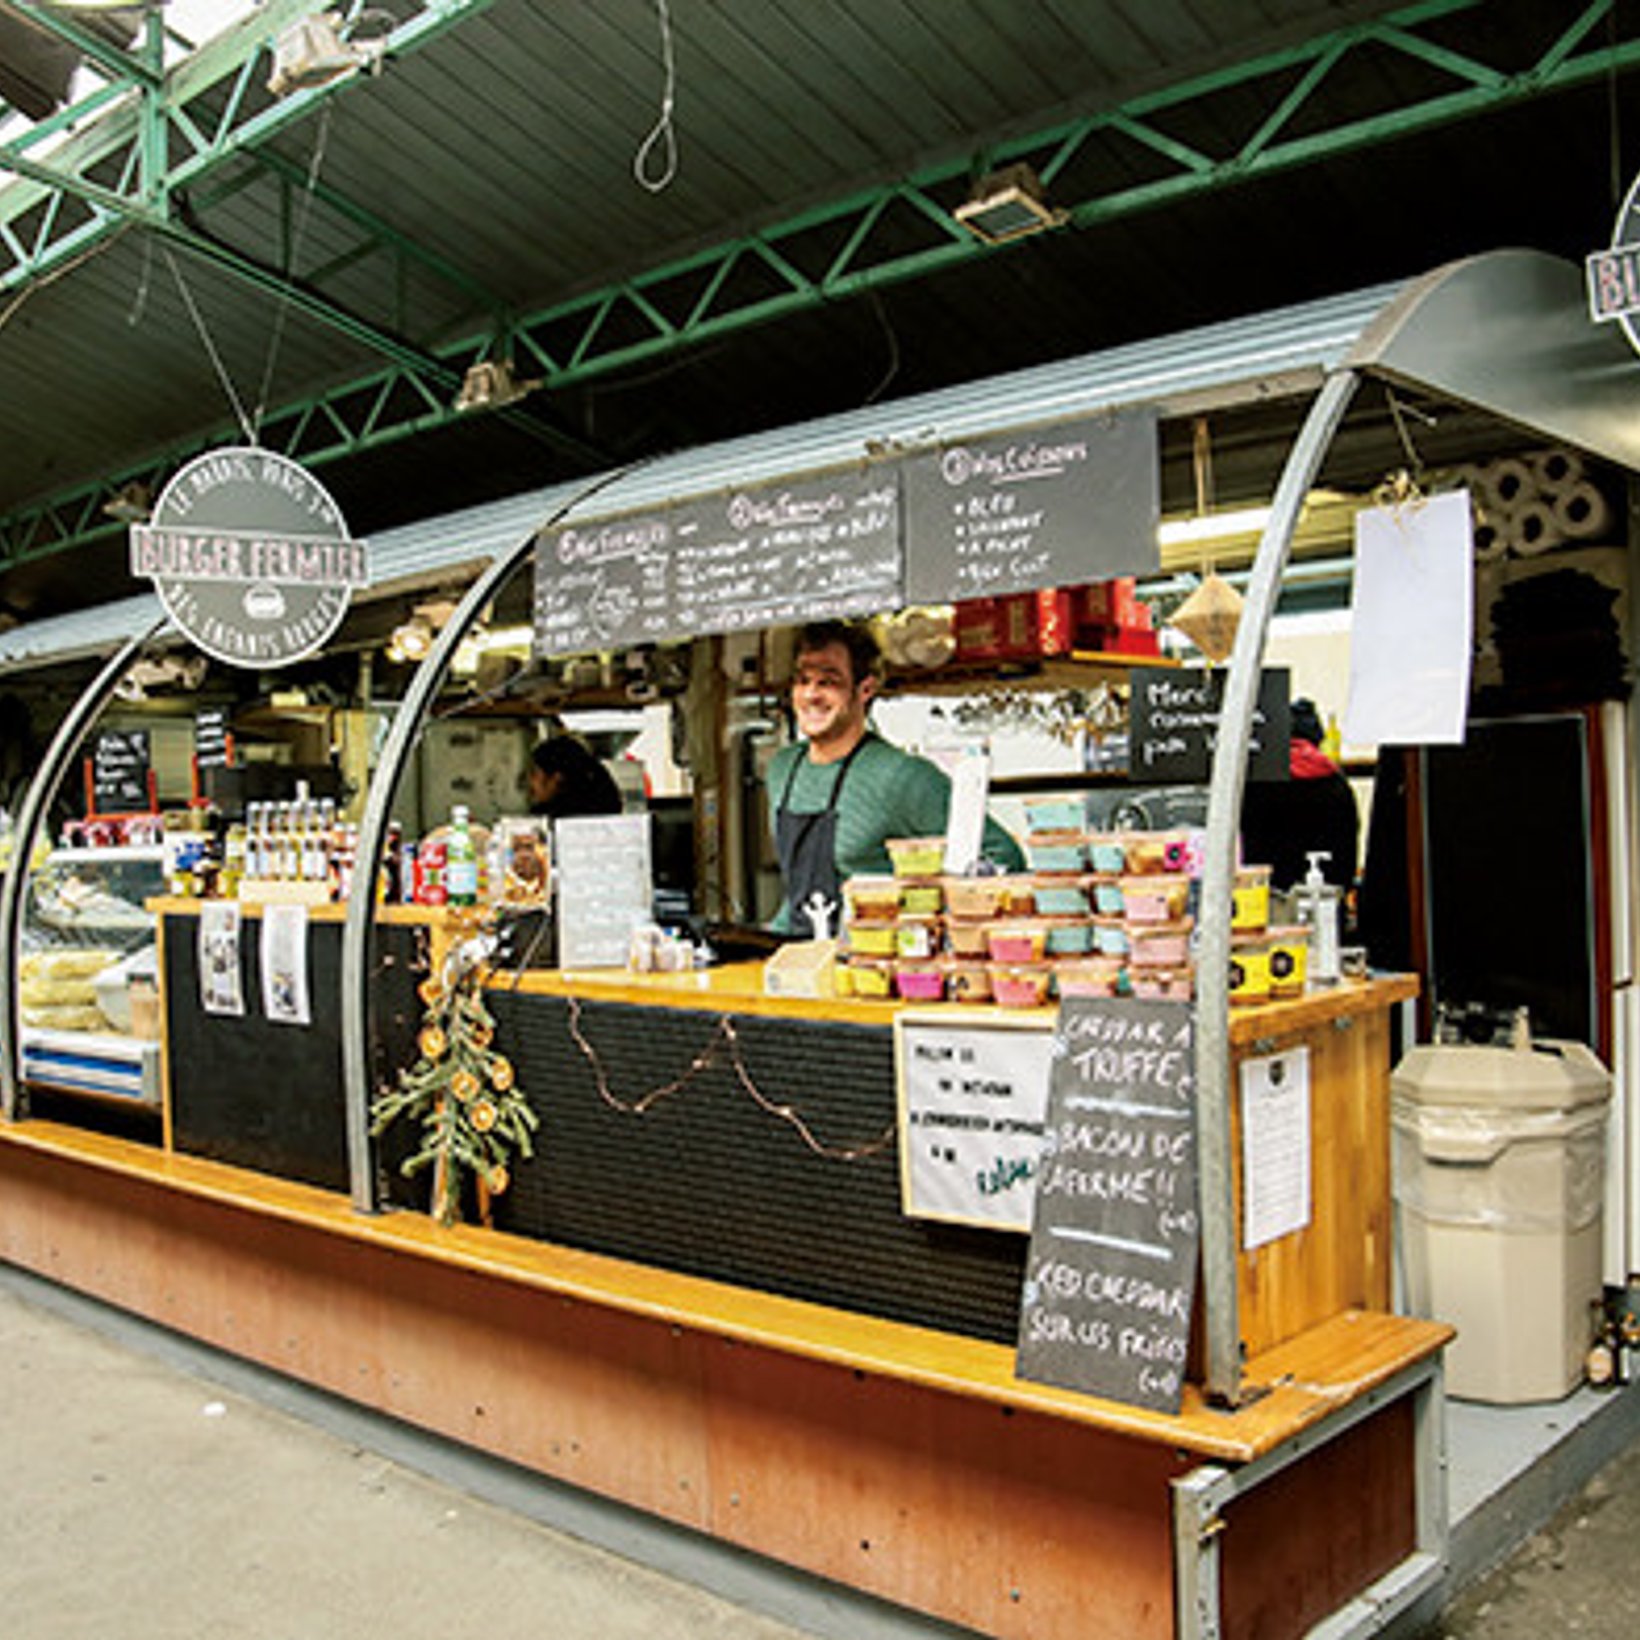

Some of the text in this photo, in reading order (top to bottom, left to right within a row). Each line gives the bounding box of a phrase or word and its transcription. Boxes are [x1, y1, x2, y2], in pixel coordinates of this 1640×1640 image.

[141, 531, 363, 581] BURGER FERMIER
[1072, 1047, 1183, 1088] TRUFFE
[1059, 1121, 1146, 1158] BACON
[1153, 1131, 1192, 1164] DE
[1028, 1306, 1076, 1345] SUR
